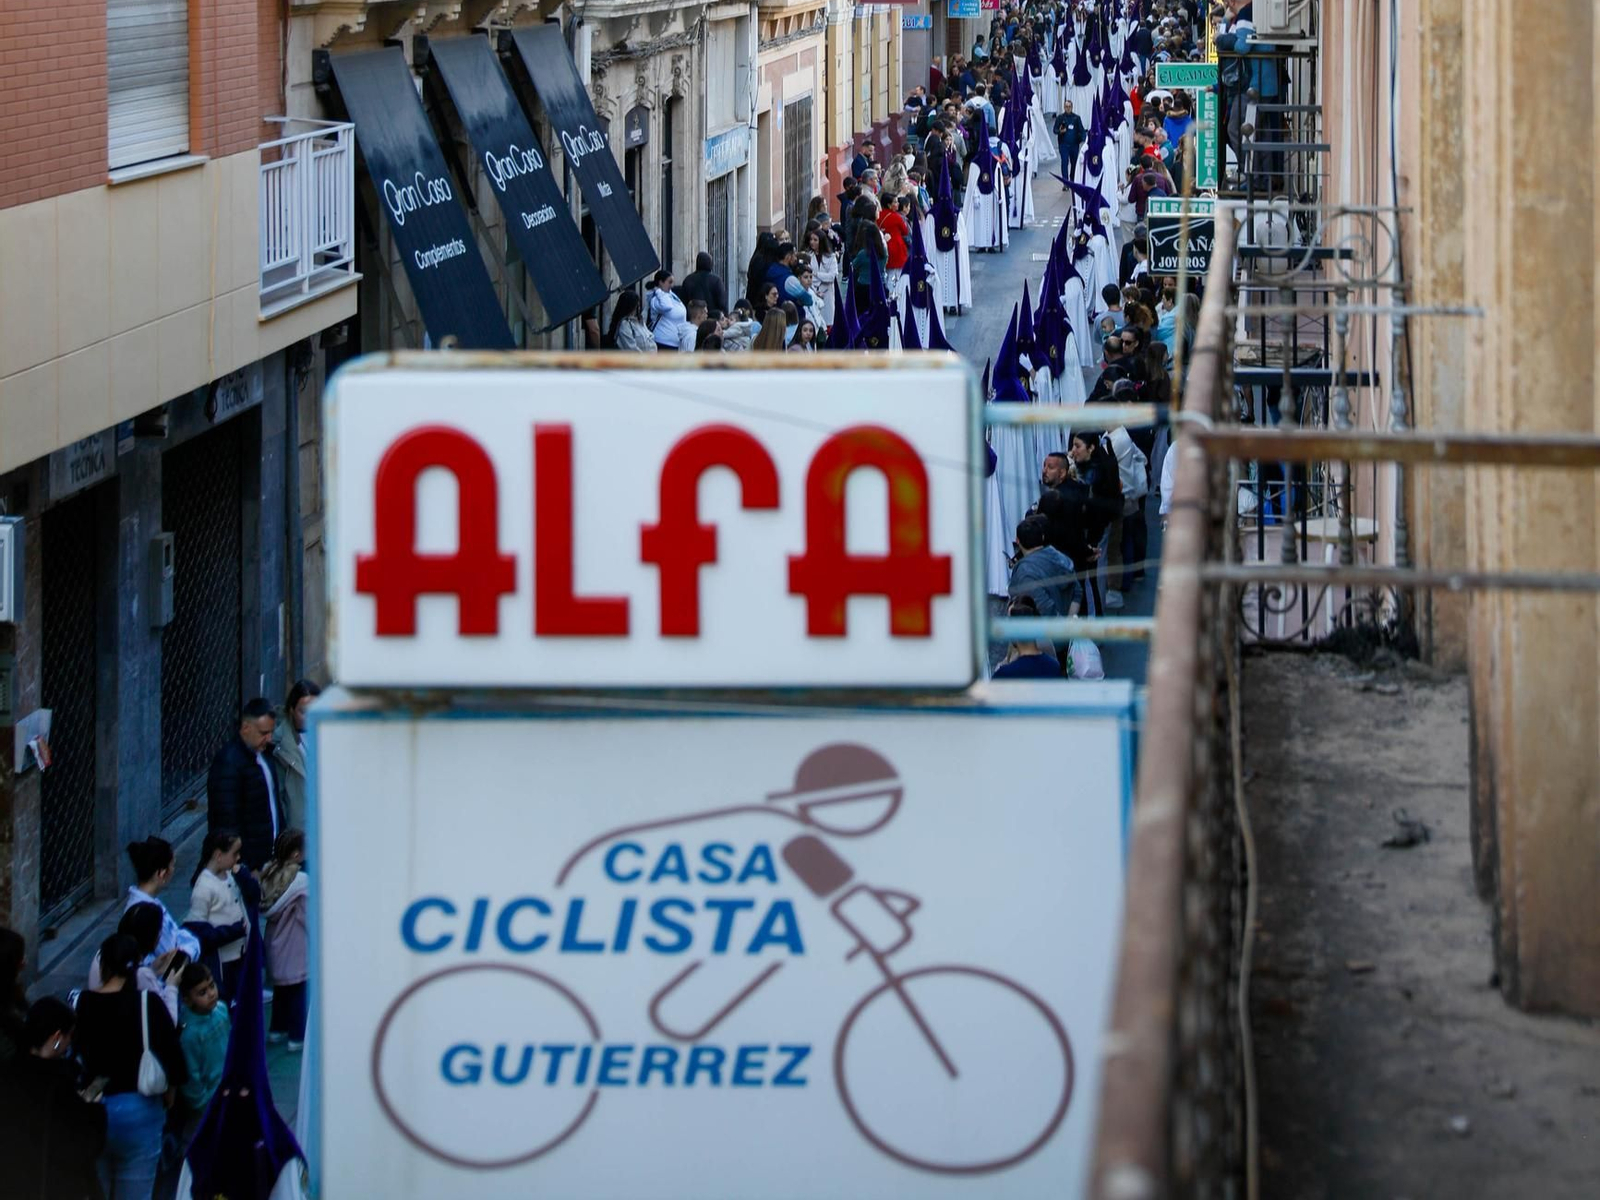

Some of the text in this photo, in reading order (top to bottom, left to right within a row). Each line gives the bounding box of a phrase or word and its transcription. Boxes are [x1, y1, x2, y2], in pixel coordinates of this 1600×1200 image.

[415, 237, 467, 269] Complementos
[355, 421, 953, 638] ALFA
[603, 841, 779, 886] CASA
[401, 896, 806, 956] CICLISTA
[439, 1044, 812, 1087] GUTIERREZ
